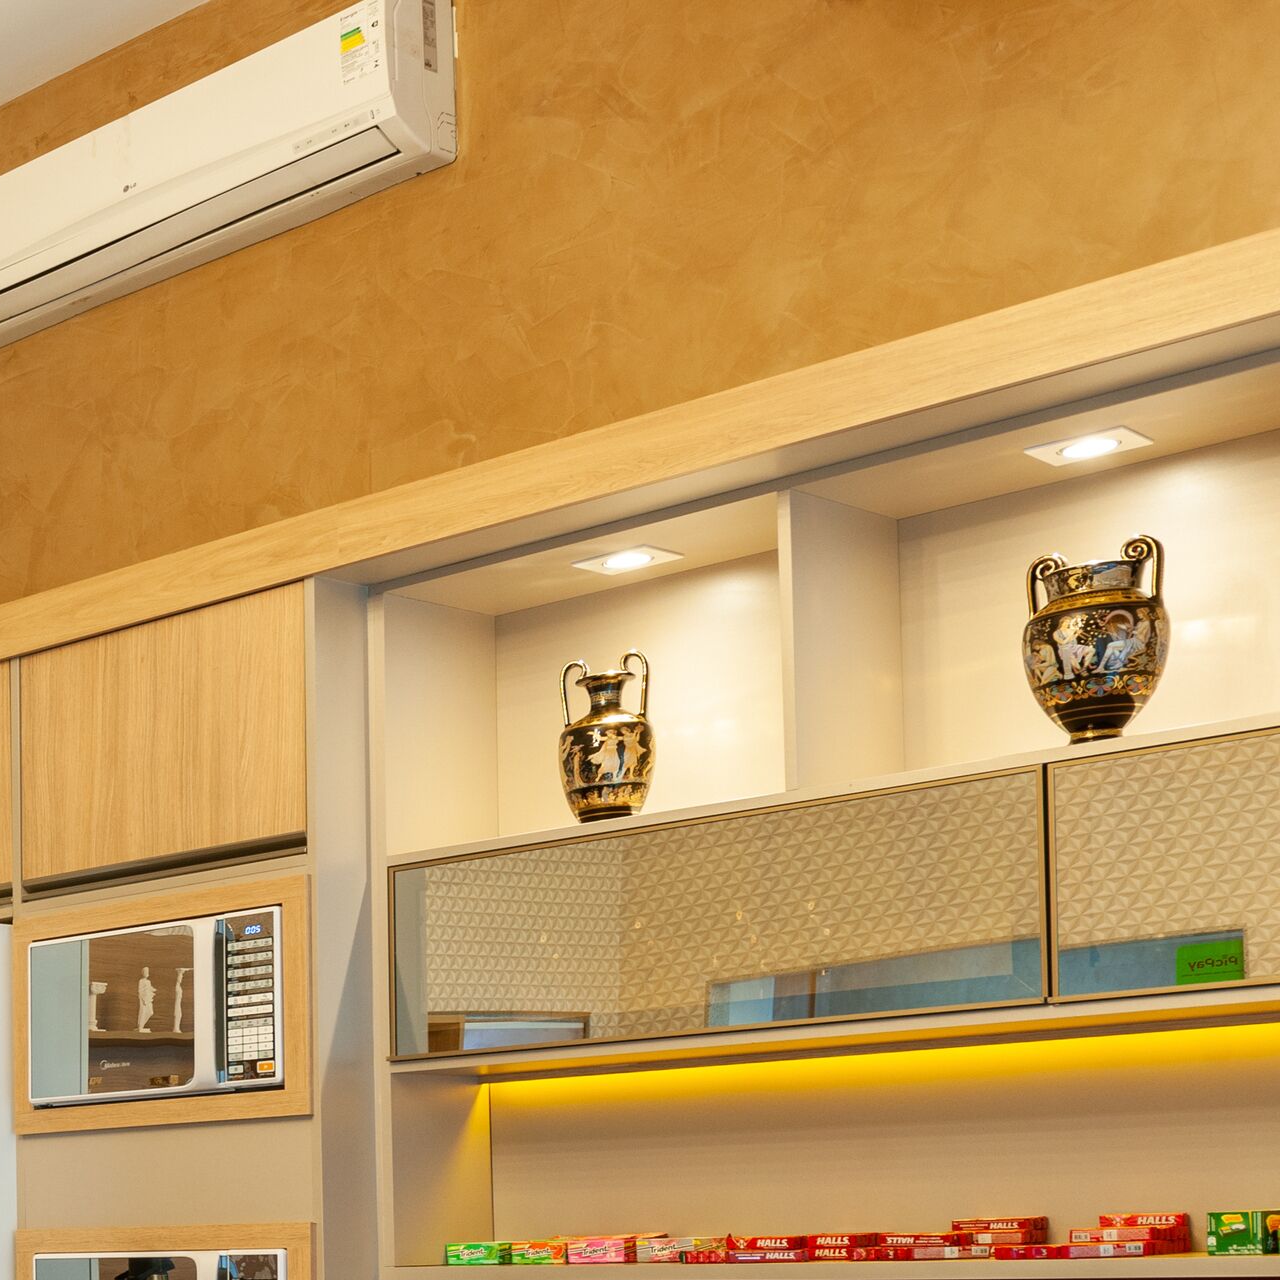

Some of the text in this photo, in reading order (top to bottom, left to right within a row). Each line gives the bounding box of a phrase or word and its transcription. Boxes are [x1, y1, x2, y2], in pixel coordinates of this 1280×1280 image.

[1137, 1215, 1176, 1225] HALLS
[989, 1222, 1018, 1230] HALLS
[756, 1238, 789, 1248] HALLS
[816, 1236, 850, 1246] HALLS
[461, 1246, 484, 1258] Trident
[525, 1246, 550, 1257] Trident
[582, 1245, 607, 1257] Trident
[650, 1243, 676, 1254] Trident
[814, 1248, 848, 1258] HALLS
[765, 1252, 796, 1260] HALLS
